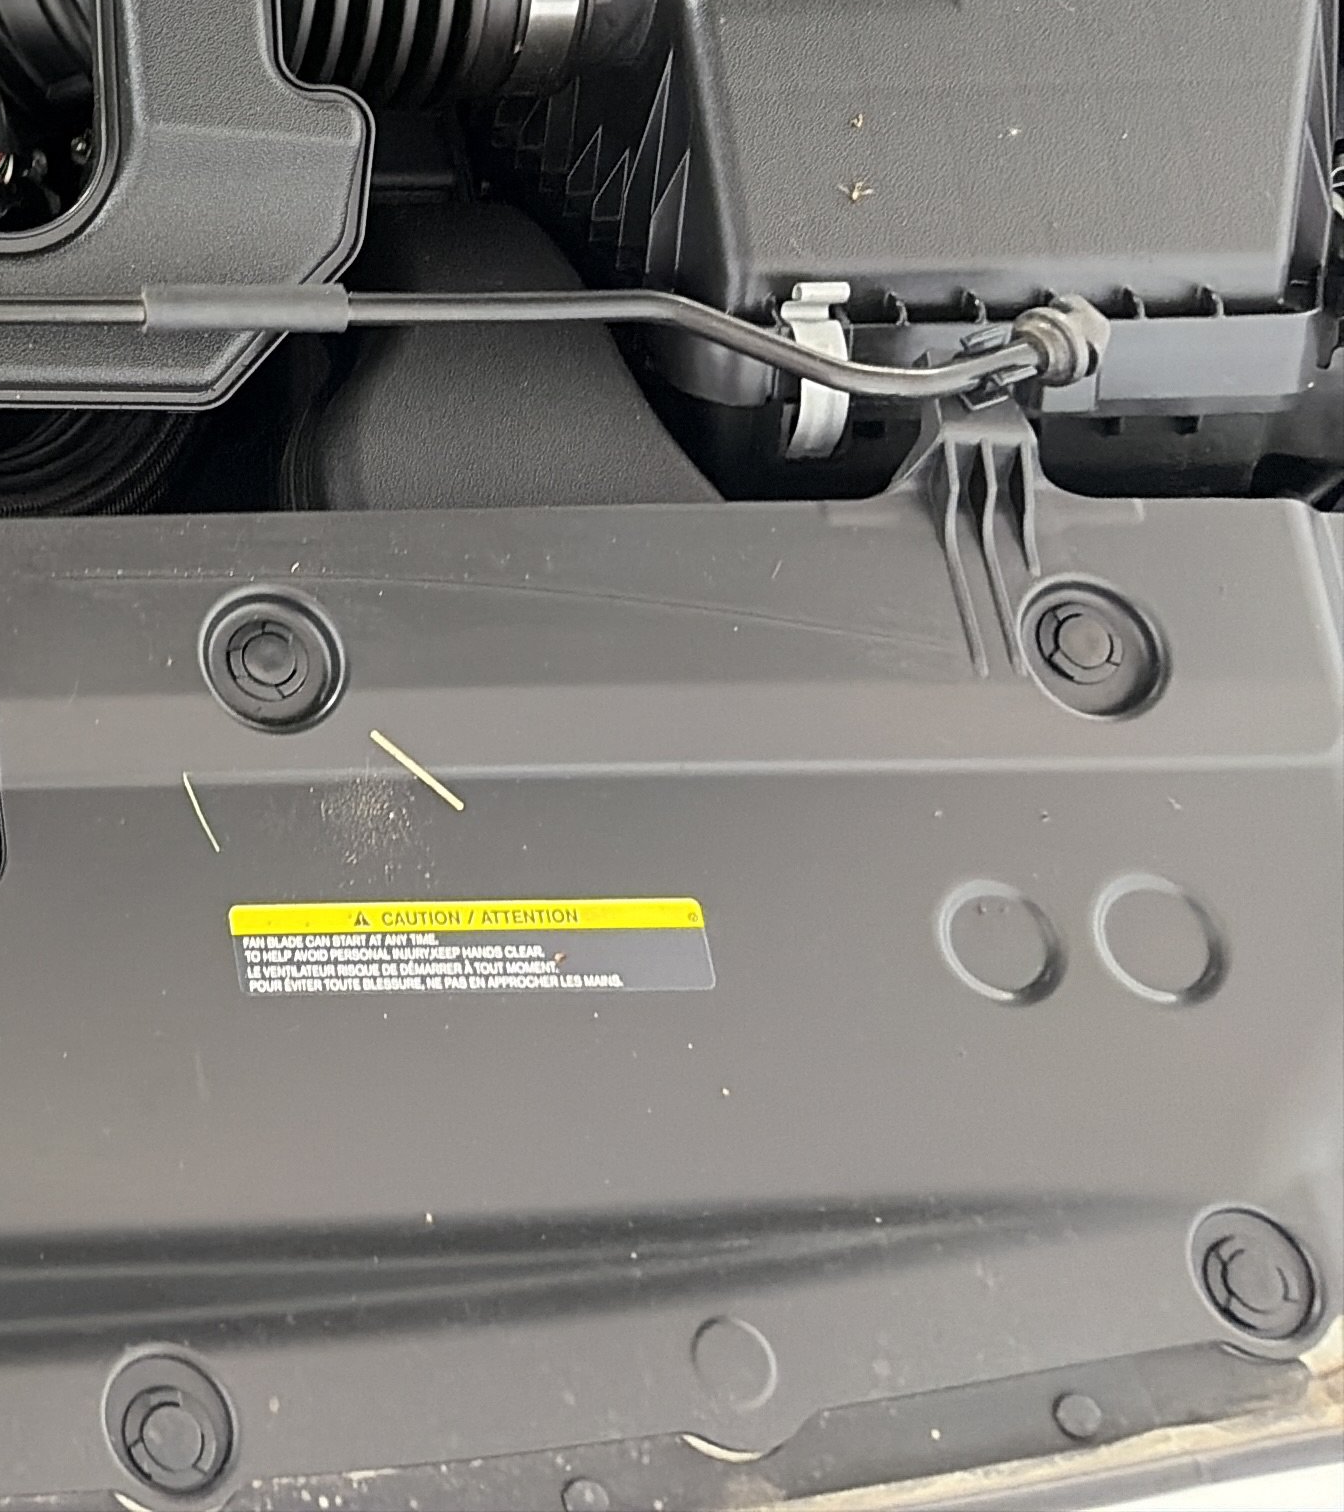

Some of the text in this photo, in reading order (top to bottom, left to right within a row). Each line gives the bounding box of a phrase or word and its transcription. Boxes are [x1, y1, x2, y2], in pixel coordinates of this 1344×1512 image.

[381, 909, 578, 927] CAUTION / ATTENTION
[242, 936, 265, 949] FAN
[267, 935, 303, 948] BLADE
[305, 935, 330, 948] CAN
[332, 934, 367, 947] START
[369, 934, 383, 947] AT
[384, 933, 408, 946] ANY
[244, 950, 260, 963] TO
[262, 949, 292, 963] HELP
[293, 949, 328, 962] AVOID
[330, 948, 390, 961] PERSONAL
[462, 946, 503, 959] HANDS
[504, 945, 545, 958] CLEAR.
[247, 966, 261, 979] LE
[262, 964, 335, 979] VENTILATEUR
[337, 963, 380, 978] RISQUE
[382, 963, 397, 977] DE
[399, 960, 462, 977] DÉMARRER
[474, 961, 503, 975] TOUT
[249, 979, 282, 993] POUR
[284, 976, 322, 992] ÉVITER
[323, 978, 360, 992] TOUTE
[362, 977, 425, 991] BLESSURE,
[426, 977, 443, 990] NE
[444, 976, 468, 990] PAS
[469, 976, 486, 989] EN
[487, 974, 559, 989] APPROCHER
[560, 974, 582, 988] LES
